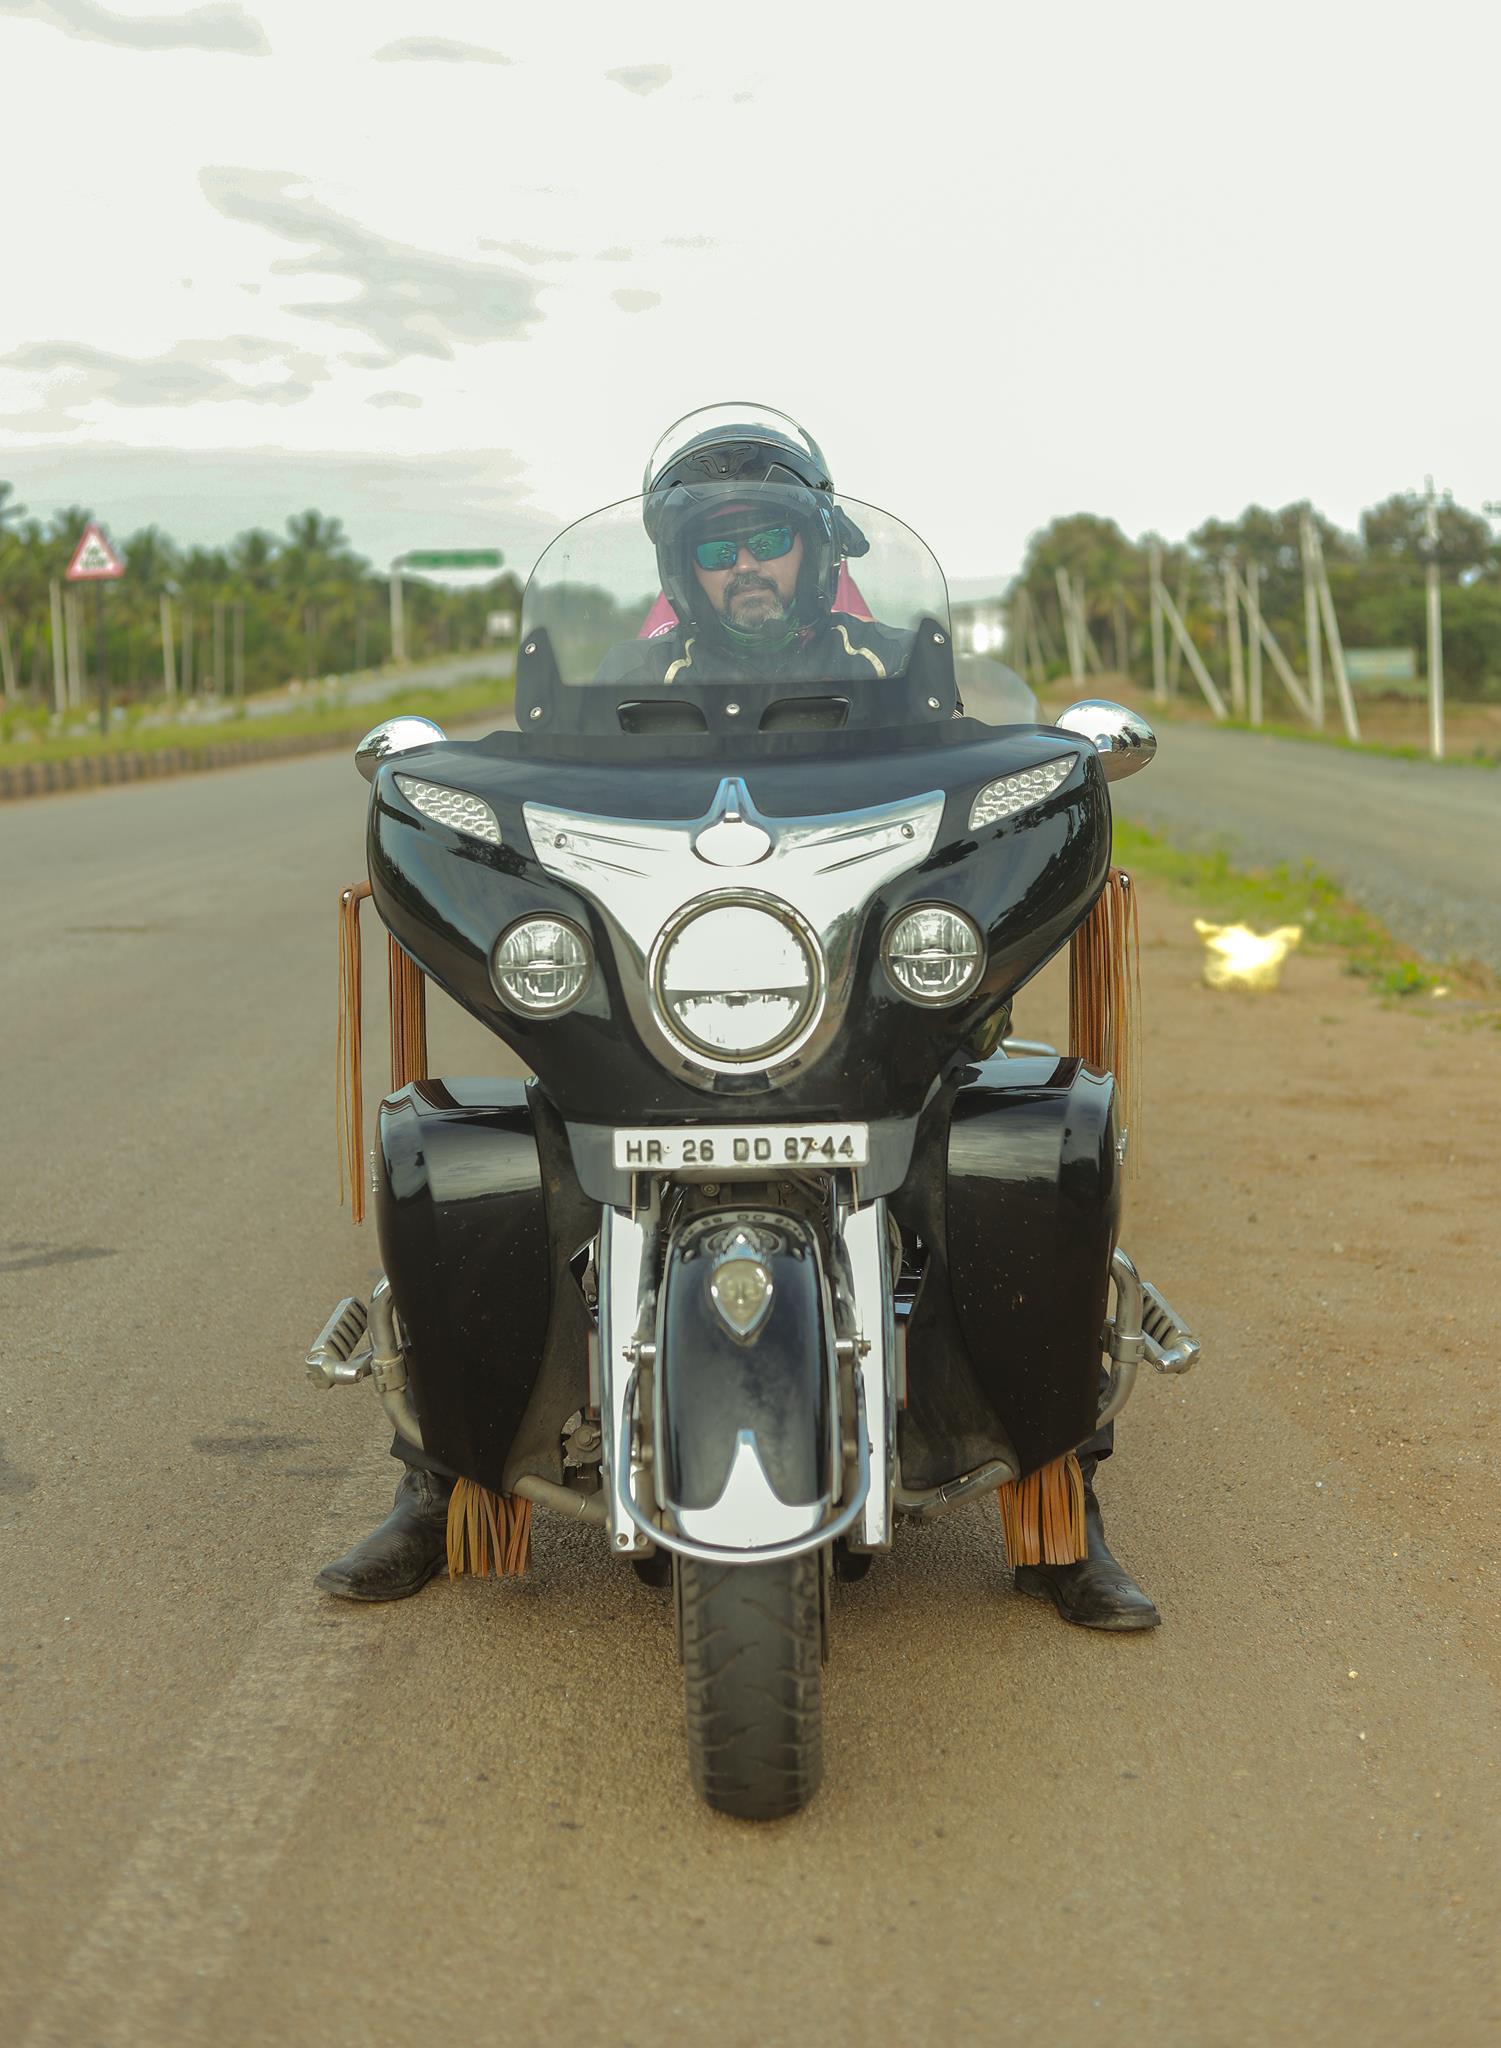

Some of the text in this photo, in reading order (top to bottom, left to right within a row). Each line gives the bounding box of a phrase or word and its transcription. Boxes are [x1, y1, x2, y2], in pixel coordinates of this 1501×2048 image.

[626, 1135, 854, 1163] HR 26 DD 8744
